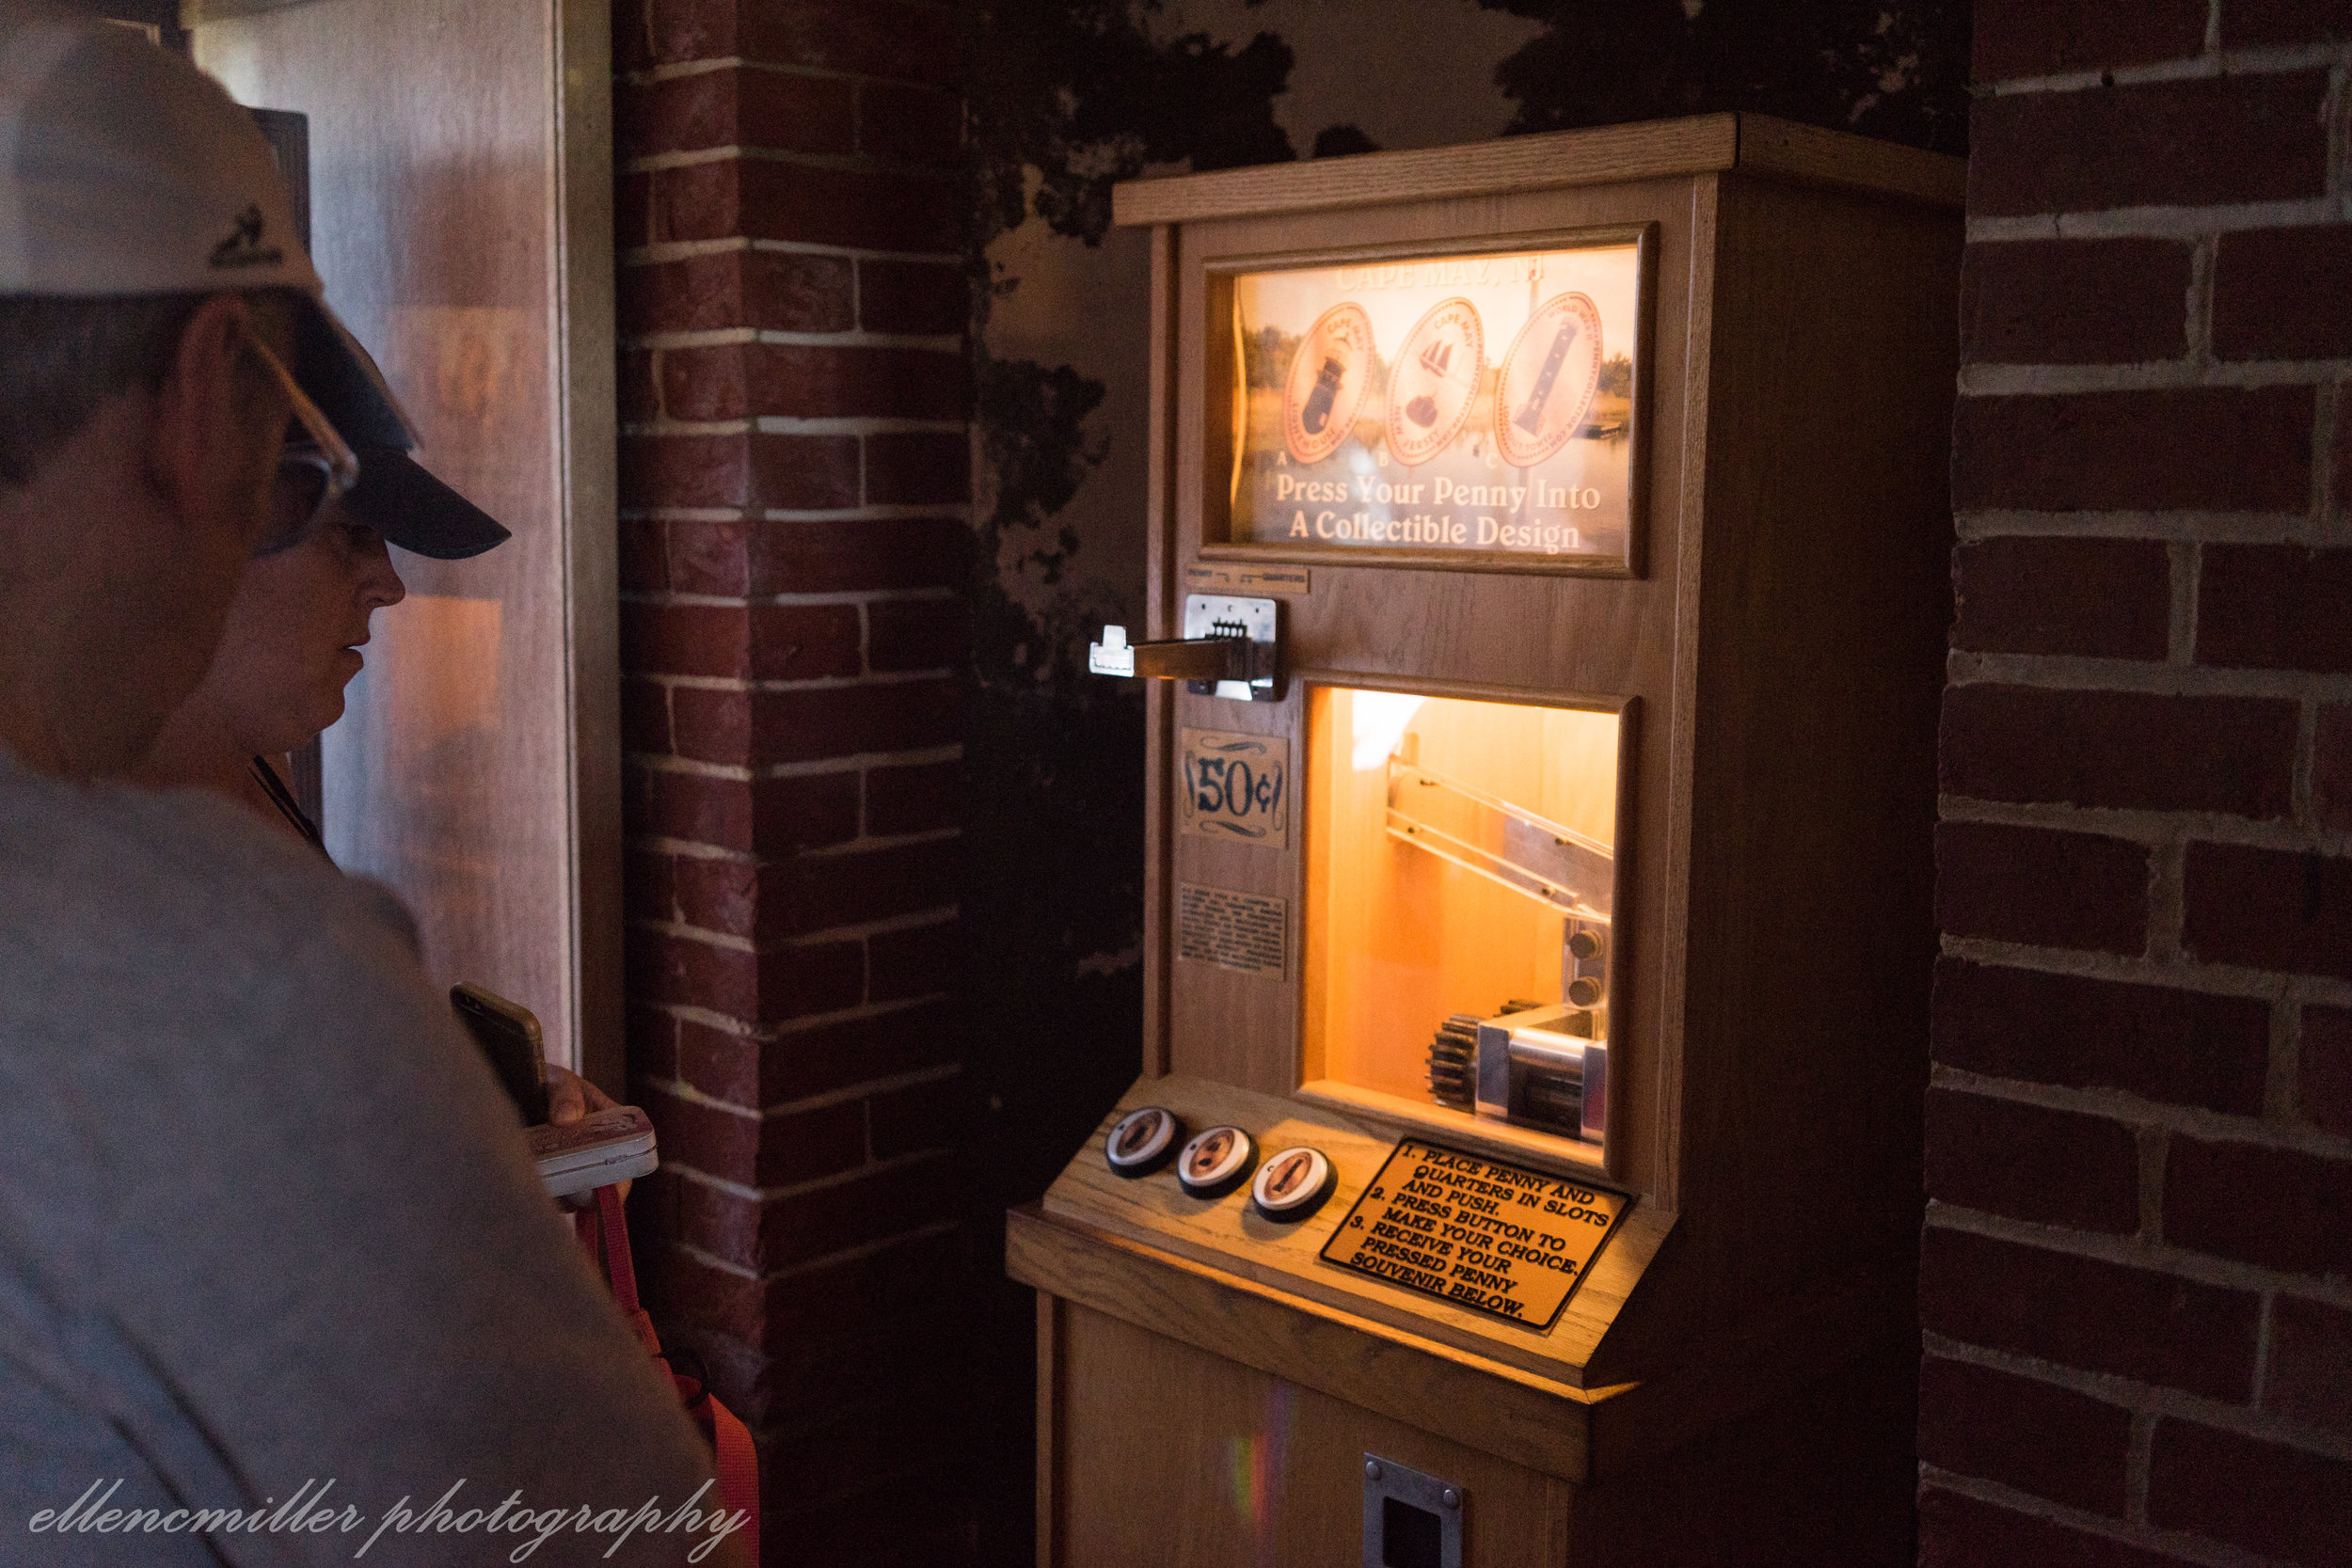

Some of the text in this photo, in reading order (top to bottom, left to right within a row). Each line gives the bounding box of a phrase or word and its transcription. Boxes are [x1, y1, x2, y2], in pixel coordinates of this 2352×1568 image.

[1338, 263, 1412, 292] CAPE
[1511, 255, 1544, 282] NJ
[1433, 313, 1475, 349] CAPE MAY
[1547, 304, 1579, 320] WORLD
[1579, 310, 1592, 331] WAR
[1394, 405, 1440, 451] NEW JERSEY
[1277, 451, 1288, 466] A
[1378, 451, 1390, 467] B
[1486, 453, 1499, 468] C
[1276, 473, 1601, 514] Press Your Penny Into
[1289, 510, 1581, 555] A Collectible Design
[1198, 757, 1272, 816] 50¢
[1401, 1179, 1500, 1216] AND PUSH.
[1402, 1145, 1596, 1205] 1. PLACE PENNY AND
[1413, 1164, 1610, 1227] QUARTERS IN SLOTS
[1370, 1186, 1566, 1252] 2. PRESS BUTTON TO
[1381, 1206, 1579, 1276] MAKE YOUR CHOICE.
[1349, 1214, 1512, 1275] 3. RECEIVE YOUR
[1360, 1236, 1518, 1294] PRESSED PENNY
[1350, 1251, 1525, 1319] SOUVENIR BELOW.
